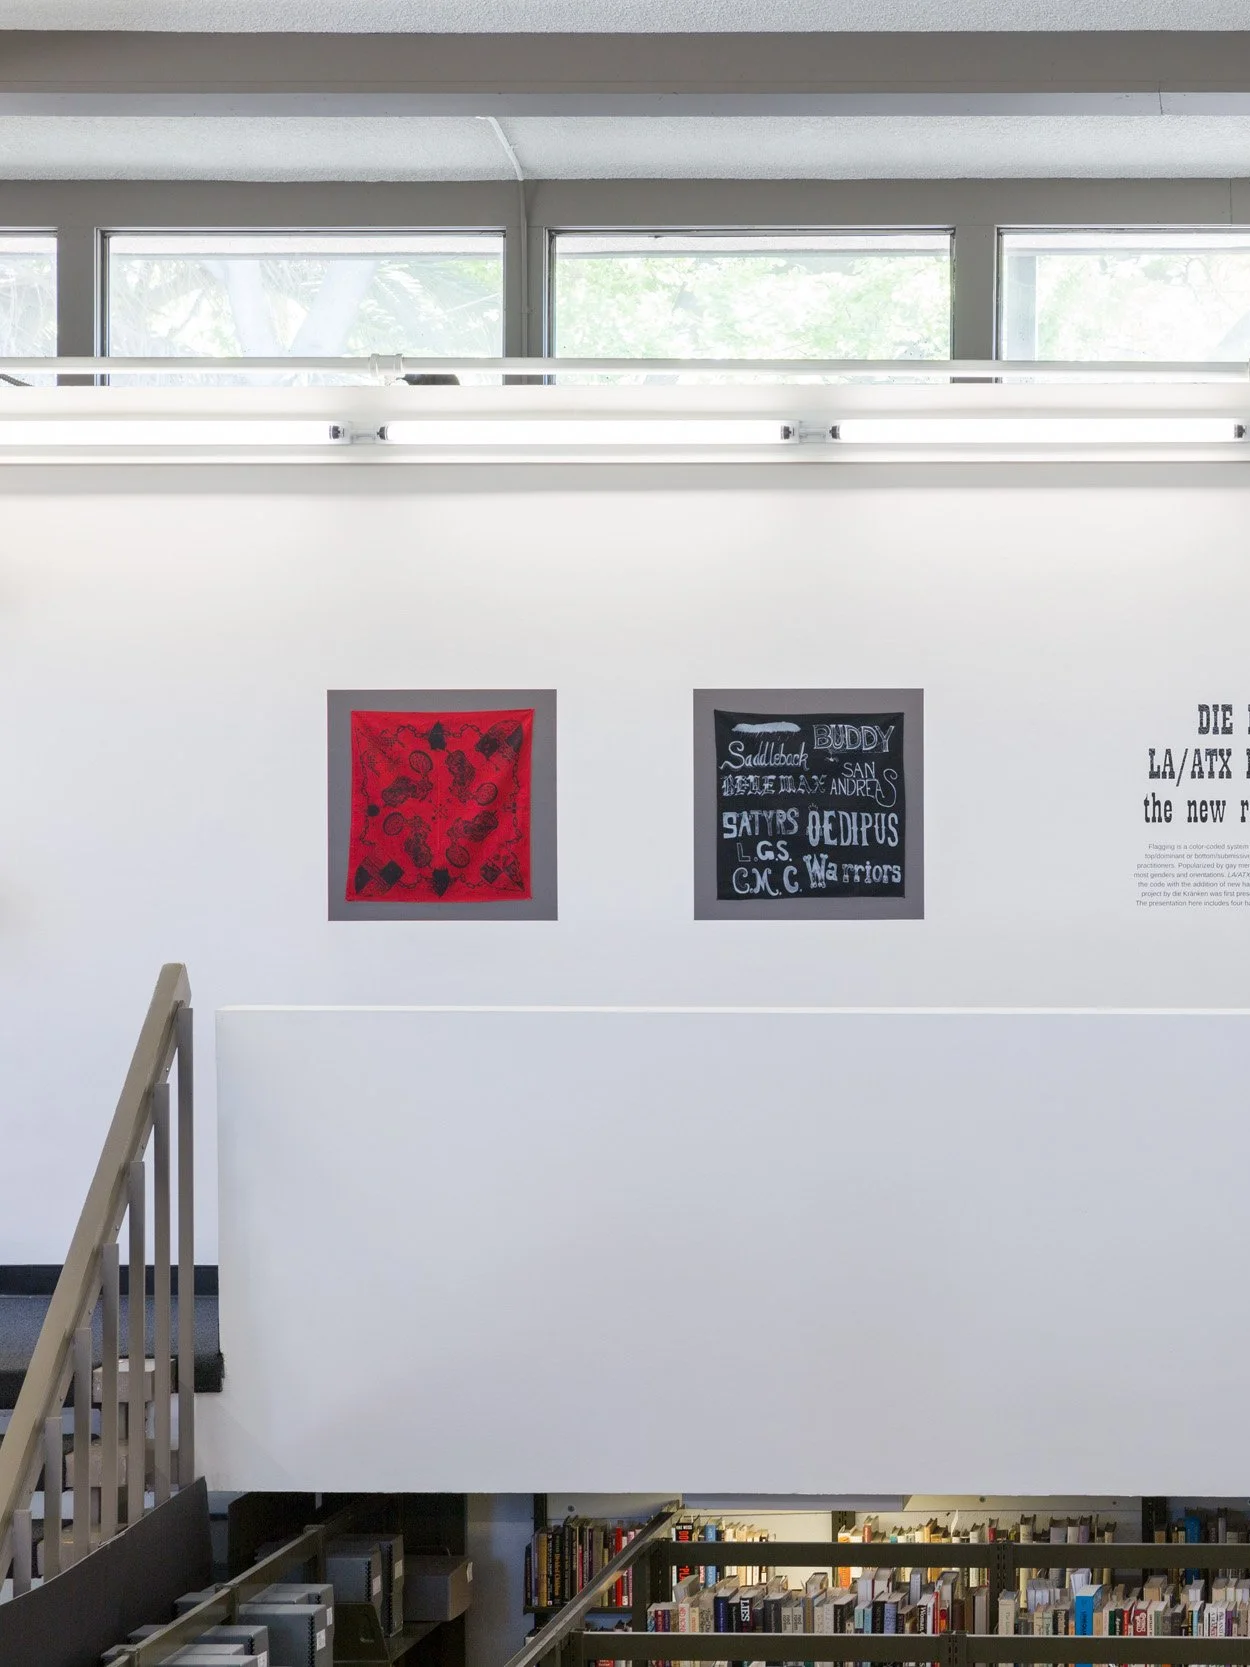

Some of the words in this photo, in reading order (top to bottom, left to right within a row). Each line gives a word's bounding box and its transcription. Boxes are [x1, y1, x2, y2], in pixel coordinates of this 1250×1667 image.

[1198, 704, 1233, 735] DIE
[813, 723, 894, 753] BUDDY
[720, 740, 809, 770] Saddleback
[1148, 748, 1232, 787] LA/ATX
[842, 762, 876, 779] SAN
[830, 768, 898, 808] ANDREAS
[1144, 792, 1173, 823] the
[1187, 800, 1226, 823] new
[722, 808, 799, 839] SATYRS
[807, 809, 899, 847] OEDIPUS
[1148, 843, 1175, 852] Flagging
[1227, 843, 1248, 852] system
[803, 853, 902, 889] Warriors
[1150, 871, 1175, 880] genders
[1178, 862, 1214, 870] Popularized
[1216, 862, 1223, 870] by
[1141, 890, 1161, 899] project
[1163, 890, 1170, 899] by
[1149, 900, 1186, 908] presentation
[740, 1600, 750, 1622] LIES
